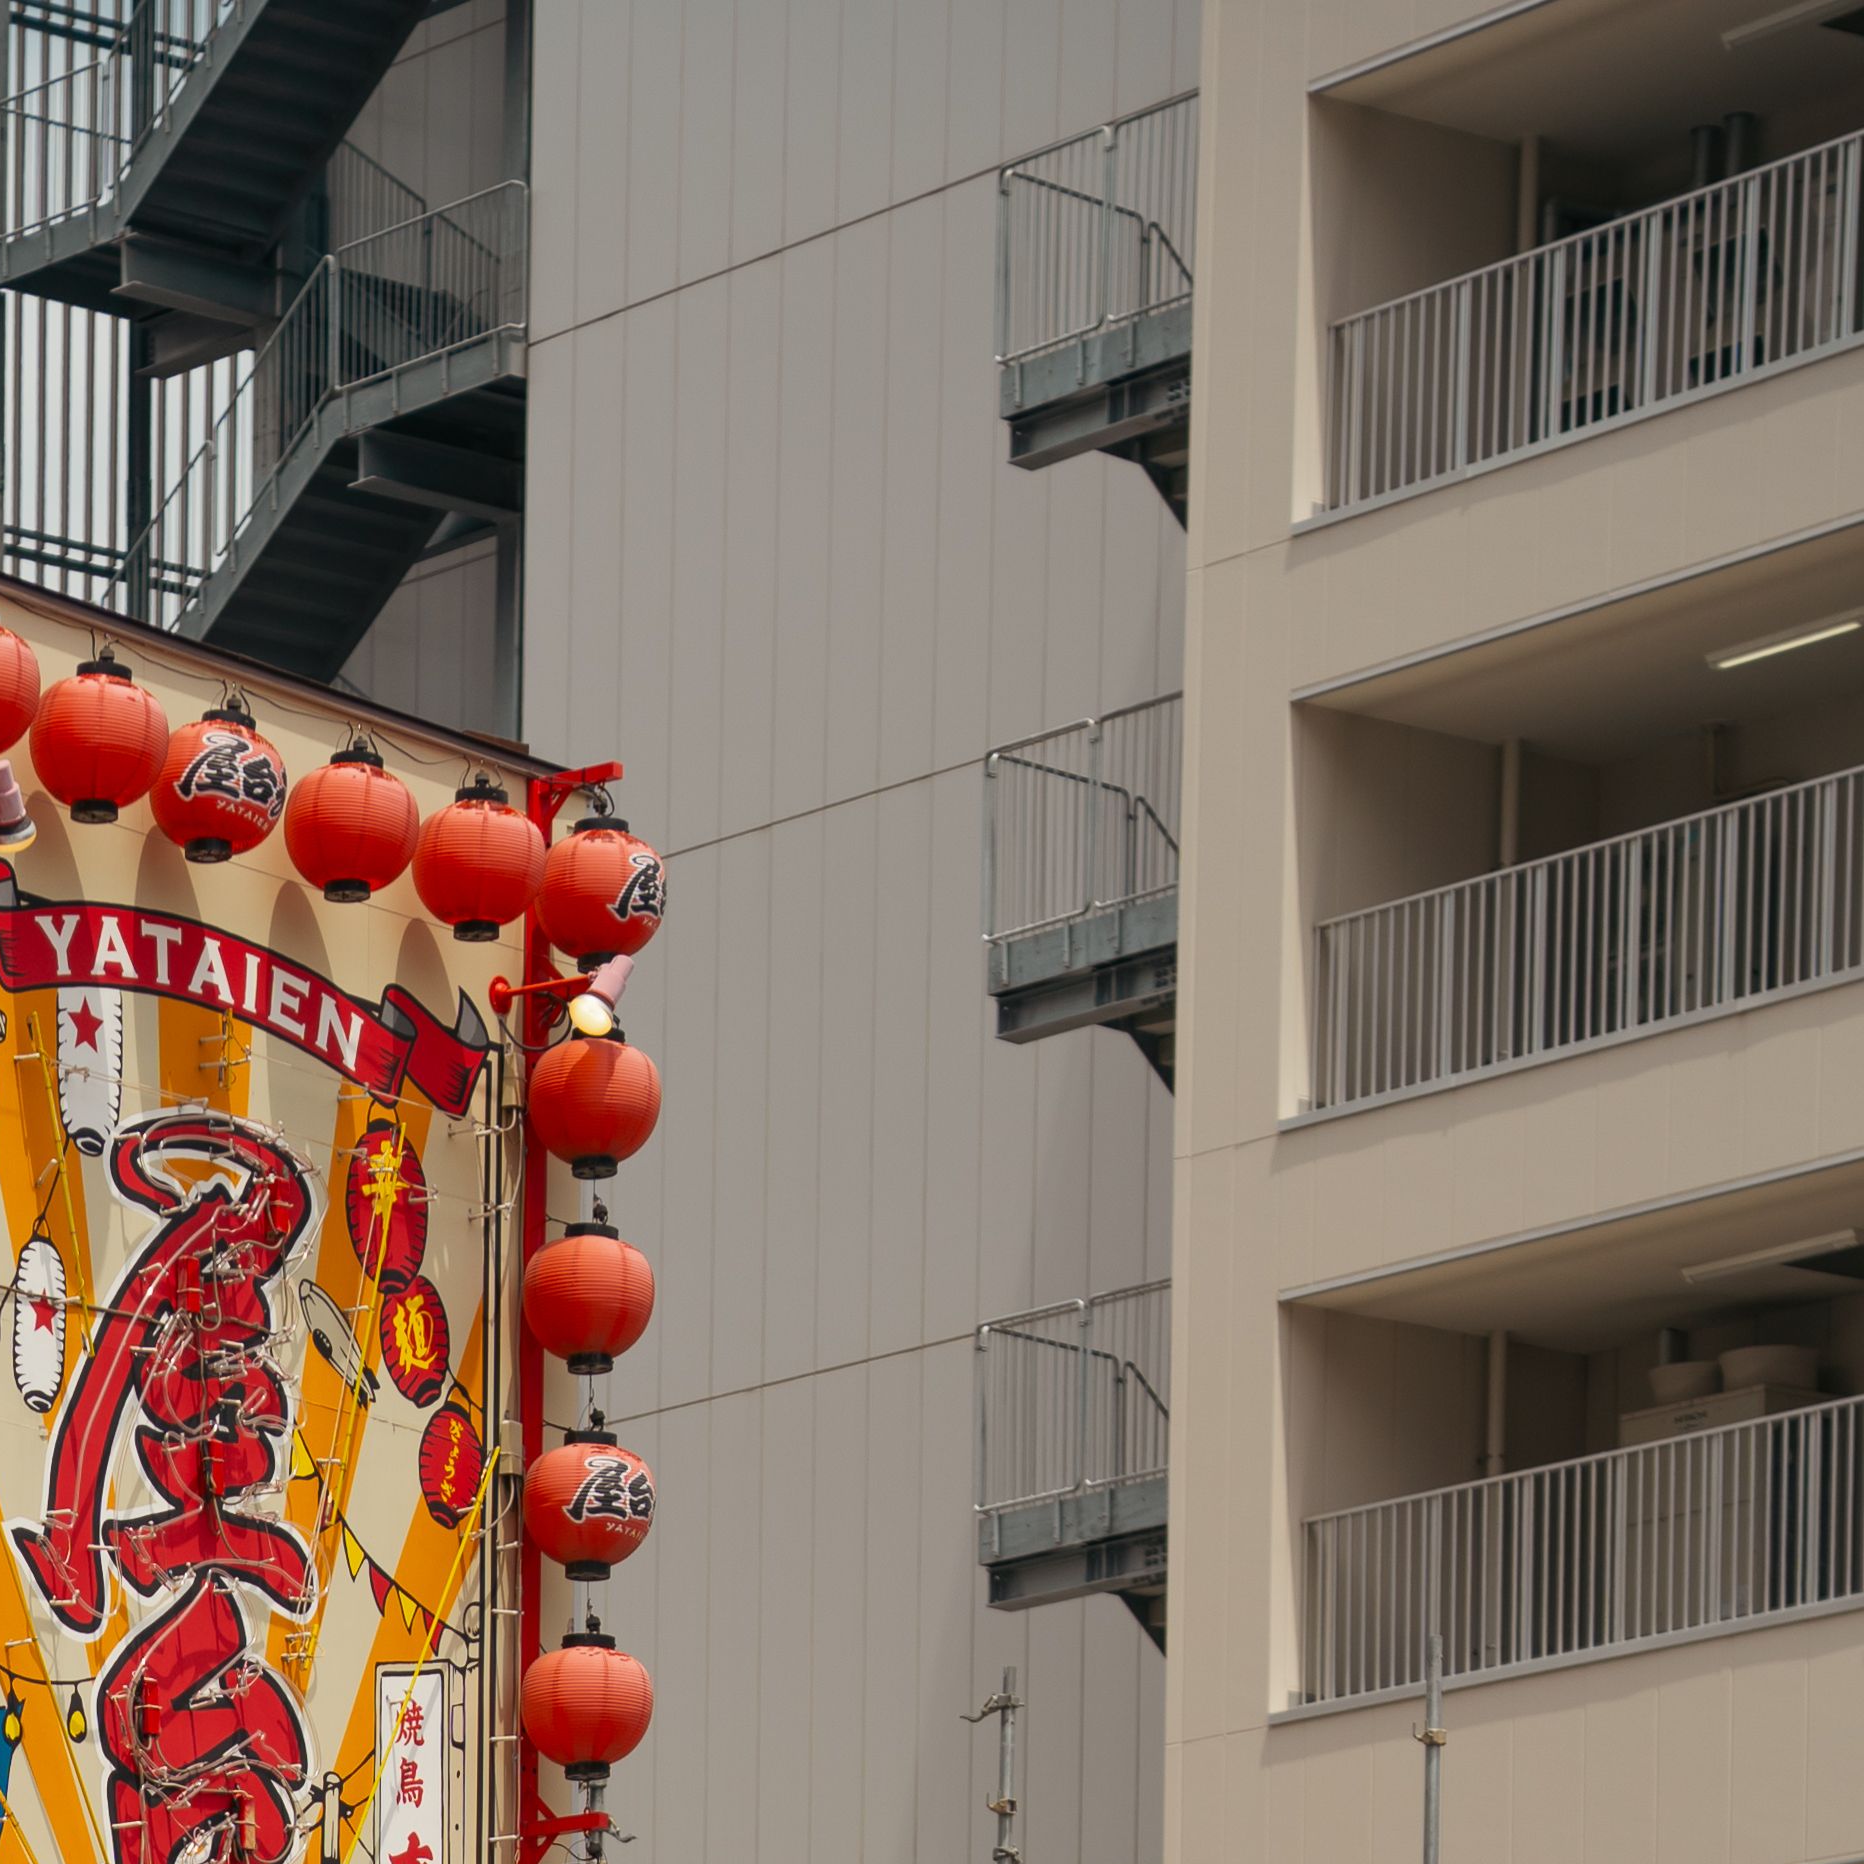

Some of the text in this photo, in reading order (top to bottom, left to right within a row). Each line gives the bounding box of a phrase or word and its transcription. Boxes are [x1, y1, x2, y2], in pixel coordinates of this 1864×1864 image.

[174, 734, 287, 820] 屋台
[606, 854, 667, 921] 屋
[34, 913, 365, 1071] YATAIEN
[562, 1455, 656, 1525] 屋台
